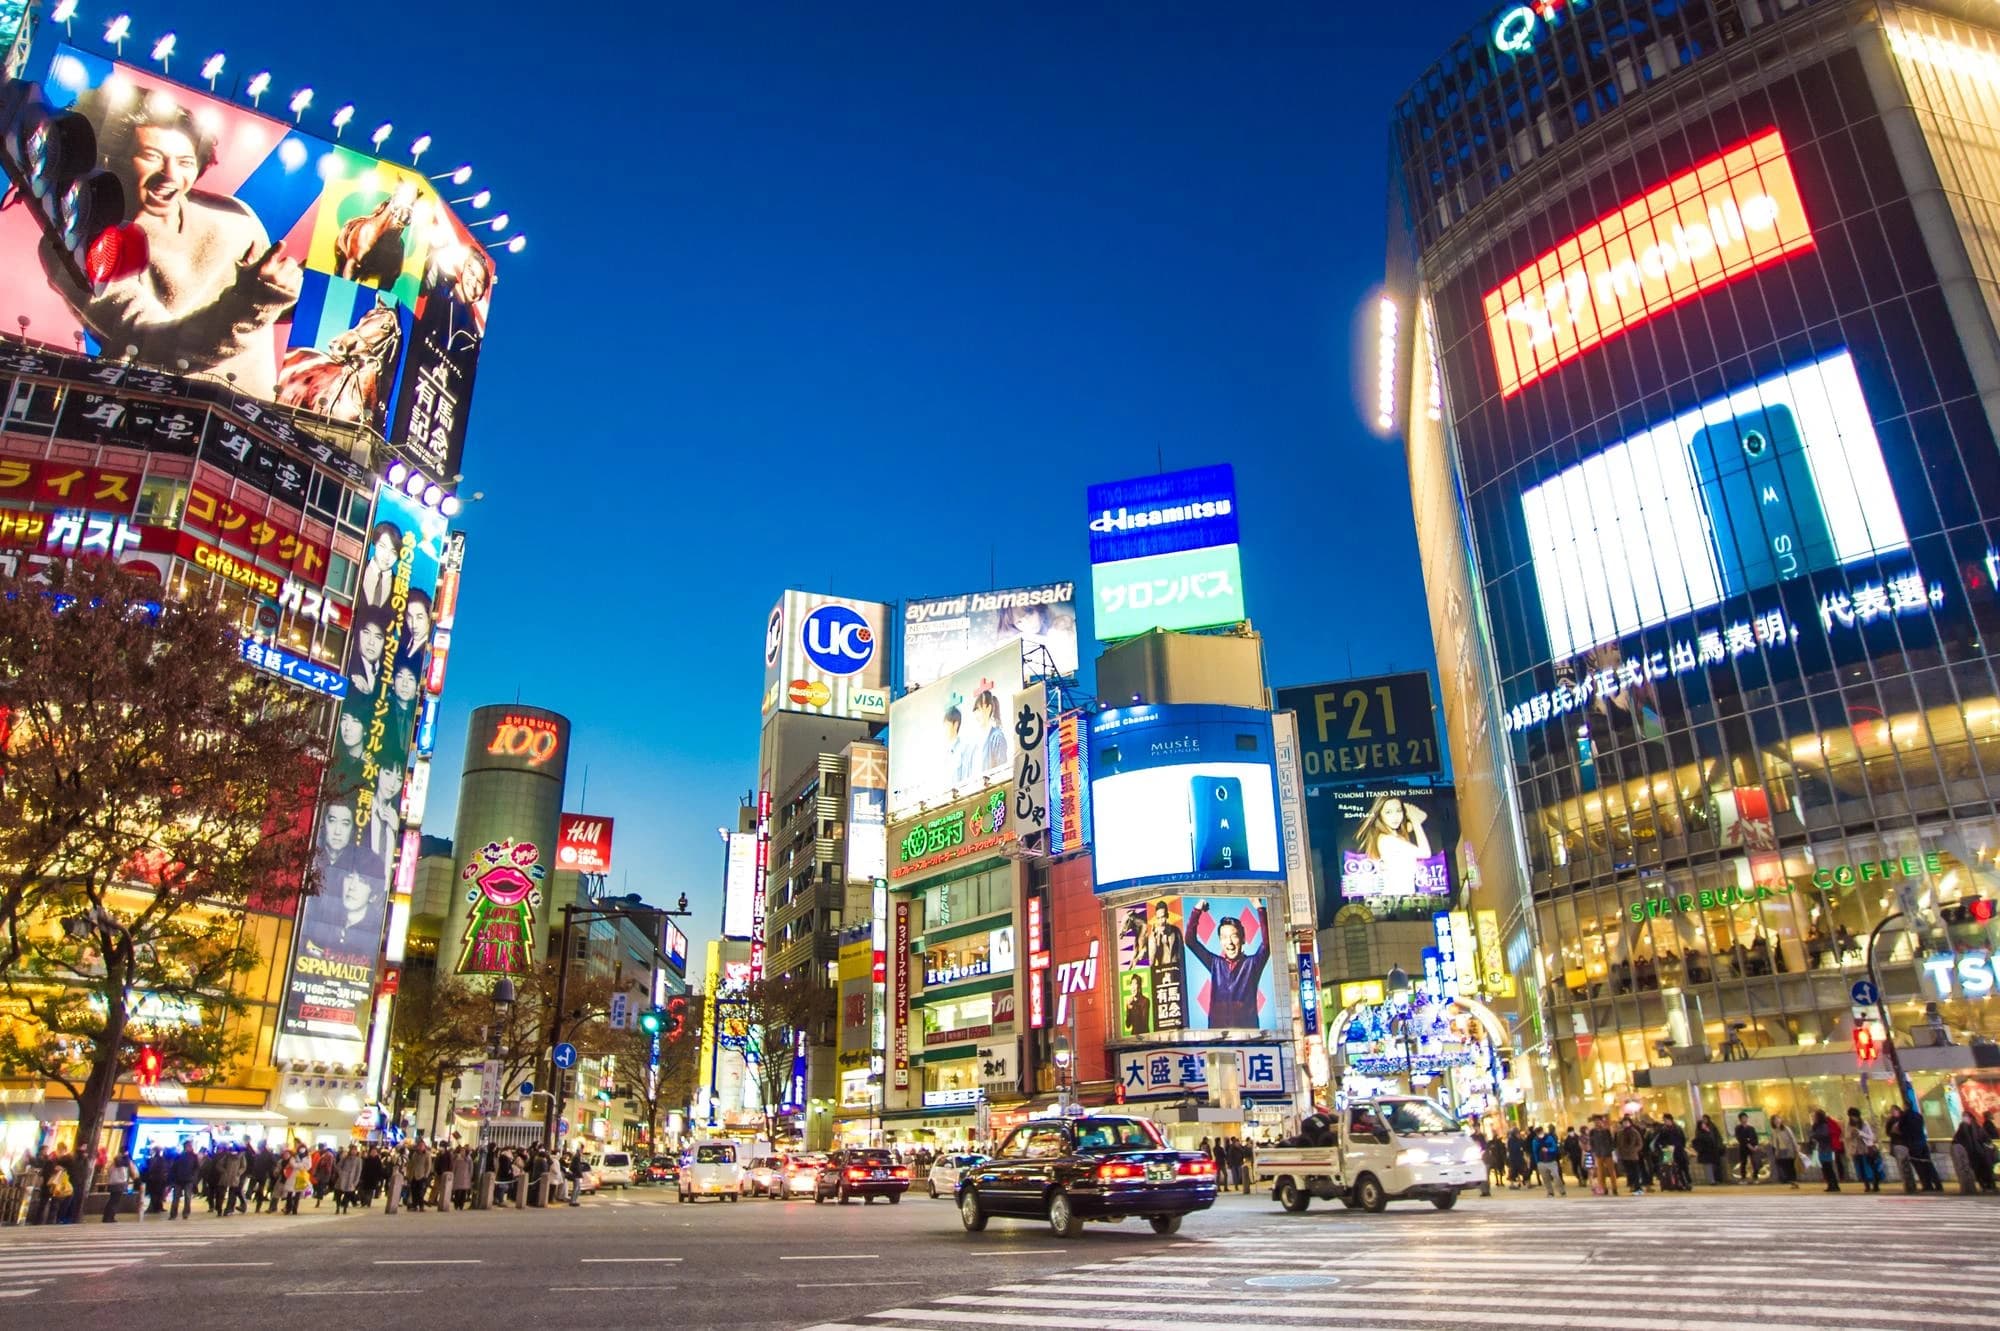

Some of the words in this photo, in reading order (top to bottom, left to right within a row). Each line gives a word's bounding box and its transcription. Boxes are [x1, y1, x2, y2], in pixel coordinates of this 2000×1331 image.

[85, 394, 104, 404] 9F
[222, 421, 236, 433] 9F
[0, 512, 44, 541] トラン
[47, 514, 142, 556] ガスト
[187, 489, 323, 570] コンタクト
[1089, 500, 1231, 533] Hisamitsu
[278, 579, 341, 626] ガスト
[906, 596, 968, 622] ayumi
[971, 583, 1073, 613] hamasaki
[1100, 570, 1234, 614] サロンパス
[239, 640, 344, 692] 会話イーオン
[854, 693, 884, 709] VISA
[1313, 684, 1397, 743] F21
[504, 715, 558, 732] SHIBUYA
[487, 722, 558, 767] 109
[1304, 742, 1405, 776] OREVER
[1406, 738, 1434, 764] 21
[1014, 703, 1046, 827] もんじゃ
[566, 820, 603, 845] H&M
[1630, 876, 1796, 923] STARBUCKS
[1812, 851, 1943, 890] COFFEE
[296, 956, 371, 982] SPAMALOT
[927, 960, 988, 986] Euphoria
[1923, 954, 2000, 999] TS
[994, 994, 1014, 1018] JTB
[1126, 1052, 1274, 1088] 大盛堂店
